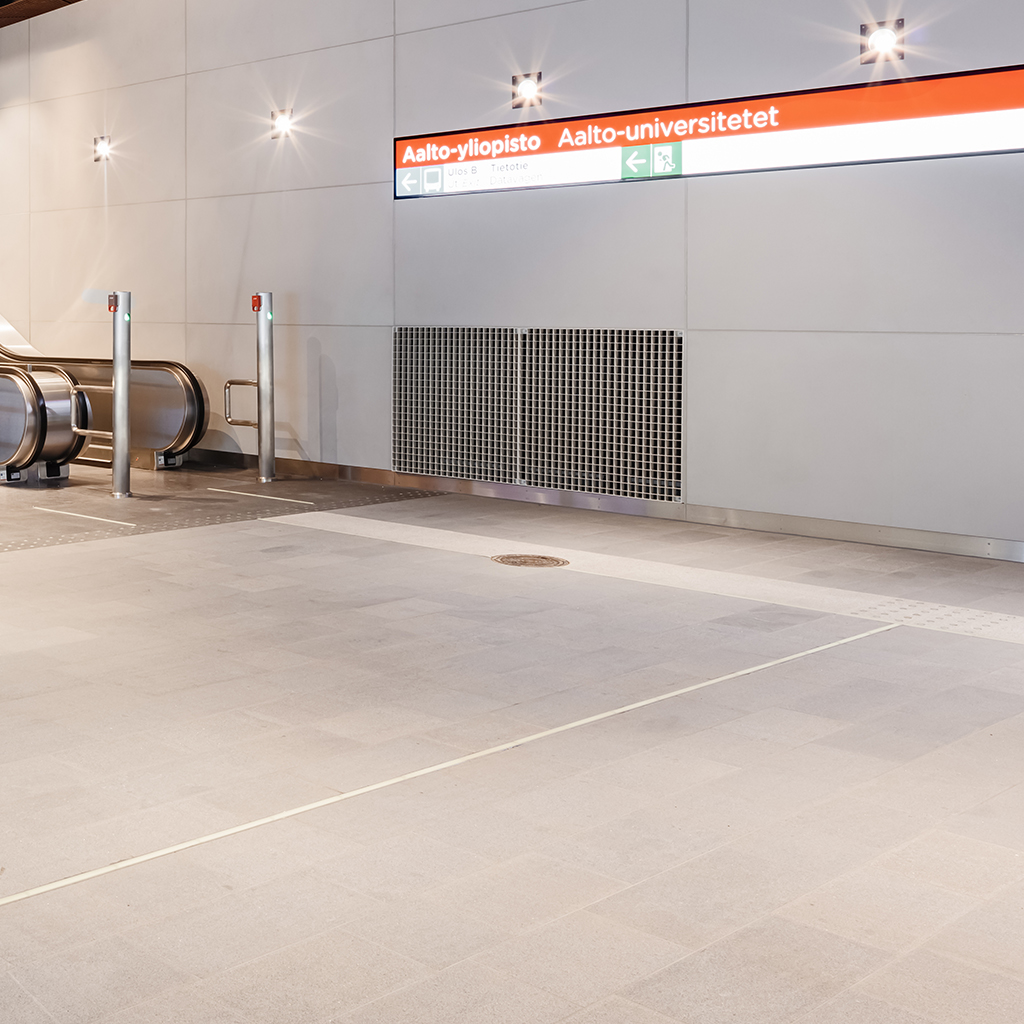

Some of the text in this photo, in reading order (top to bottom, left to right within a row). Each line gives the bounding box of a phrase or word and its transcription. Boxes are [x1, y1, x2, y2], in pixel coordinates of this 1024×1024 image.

[402, 106, 779, 162] Aalto-yliopisto Aalto-universitetet
[491, 162, 529, 173] Tietotie
